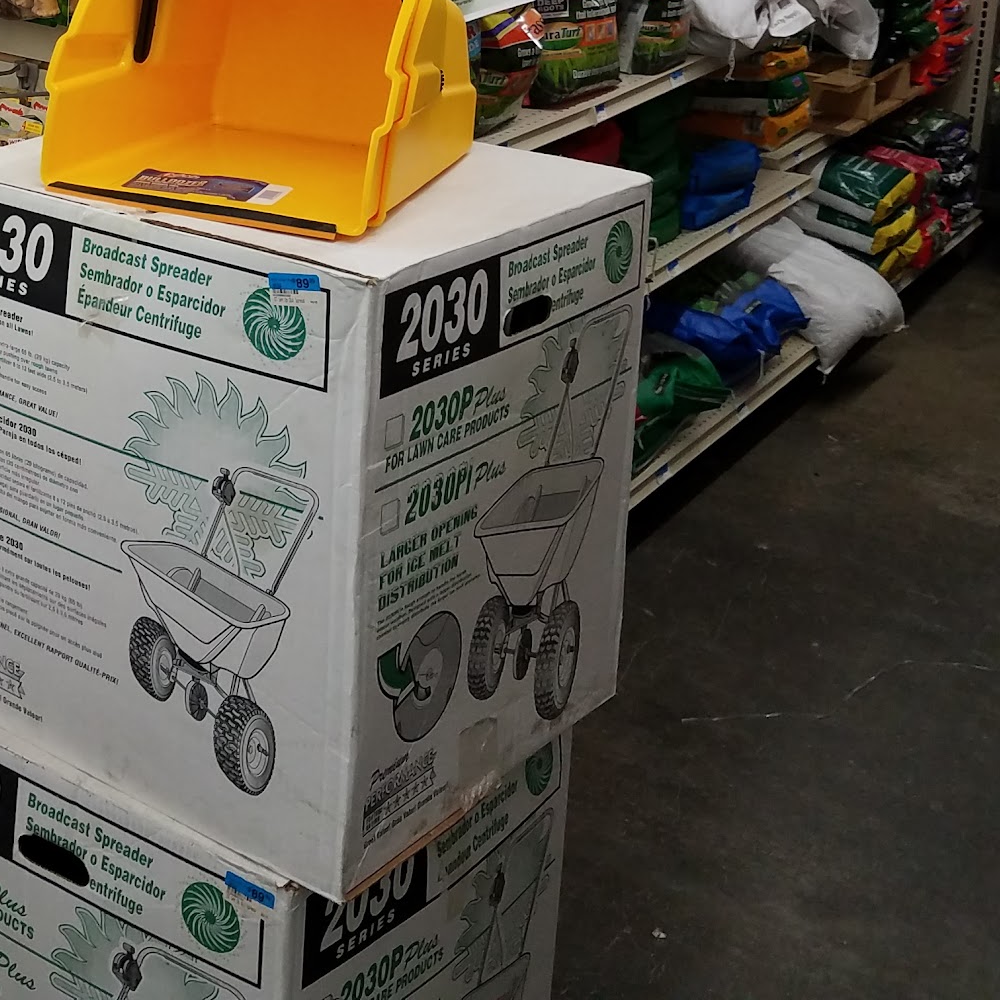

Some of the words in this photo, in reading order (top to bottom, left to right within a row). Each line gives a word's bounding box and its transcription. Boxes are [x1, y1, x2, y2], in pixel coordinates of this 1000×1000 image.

[538, 4, 565, 12] ROOTS
[81, 237, 148, 270] Broadcast
[150, 256, 213, 288] Spreader
[508, 250, 550, 278] Broadcast
[552, 236, 589, 261] Spreader
[77, 287, 133, 319] Épandeur
[135, 305, 202, 340] Centrifuge
[79, 262, 144, 295] Sembrador
[146, 284, 154, 296] o
[156, 286, 226, 319] Esparcidor
[396, 268, 489, 363] 2030
[411, 343, 471, 378] SERIES
[18, 397, 36, 410] GREAT
[38, 404, 59, 418] VALUE!
[409, 384, 474, 442] 2030P
[473, 386, 506, 416] Plus
[385, 450, 405, 474] FOR
[407, 437, 434, 463] LAWN
[436, 427, 462, 450] CARE
[463, 404, 510, 437] PRODUCTS
[473, 460, 507, 490] Plus
[6, 536, 24, 550] 2030
[379, 566, 402, 590] FOR
[406, 554, 426, 577] ICE
[429, 534, 461, 562] MELT
[380, 532, 427, 568] LARGER
[431, 504, 478, 542] OPENING
[378, 554, 459, 612] DISTRIBUTION
[13, 628, 46, 650] EXCELLENT
[46, 644, 74, 664] RAPPORT
[74, 657, 119, 686] QUALITÉ-PRIX!
[25, 816, 88, 860] Sembrador
[89, 850, 99, 867] o
[100, 854, 167, 902] Esparcidor
[27, 792, 91, 838] Broadcast
[94, 826, 154, 870] Spreader
[88, 877, 144, 917] entrifuge
[336, 909, 396, 960] SERIES
[341, 944, 404, 1000] 2030P
[402, 934, 439, 969] Plus
